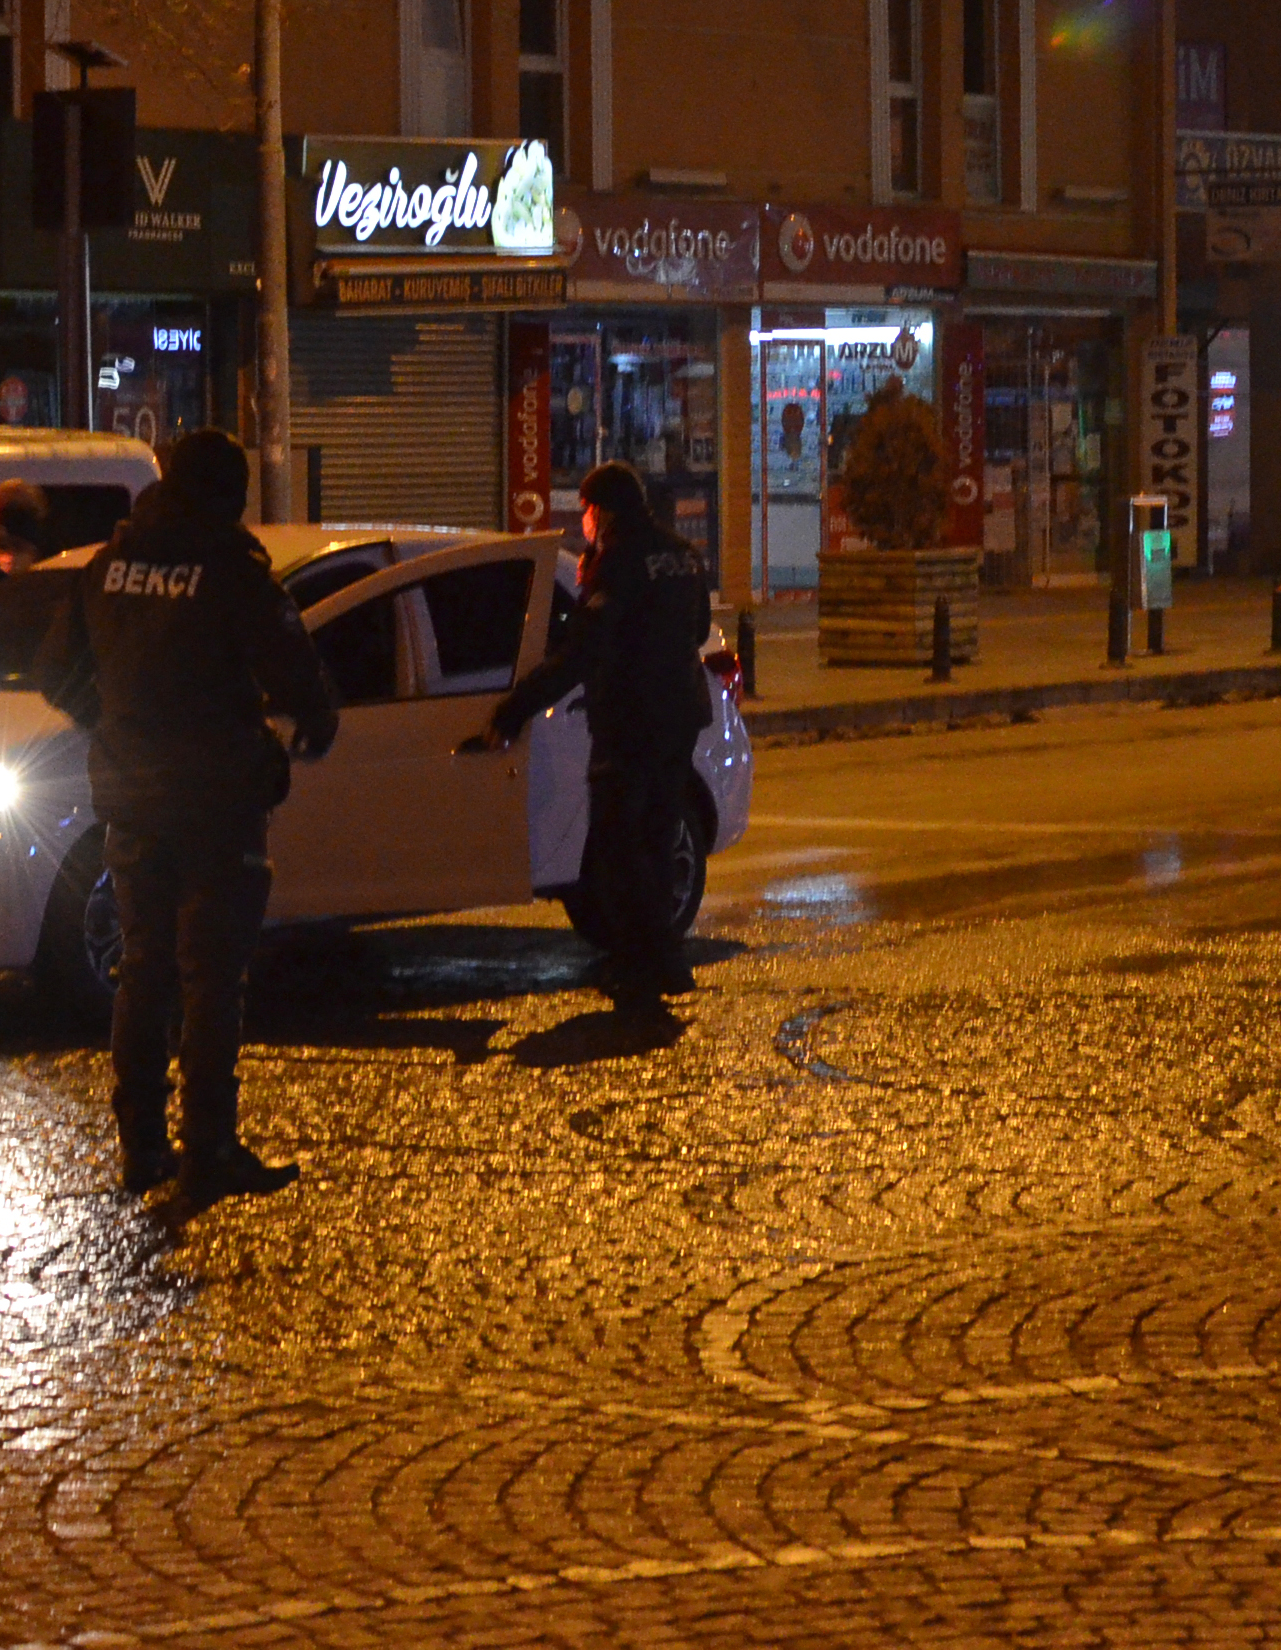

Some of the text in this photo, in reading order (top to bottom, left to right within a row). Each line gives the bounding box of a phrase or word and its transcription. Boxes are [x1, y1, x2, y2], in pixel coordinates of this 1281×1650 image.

[315, 151, 492, 246] Veziroğlu
[594, 217, 731, 262] vodafone
[823, 223, 947, 265] vodafone
